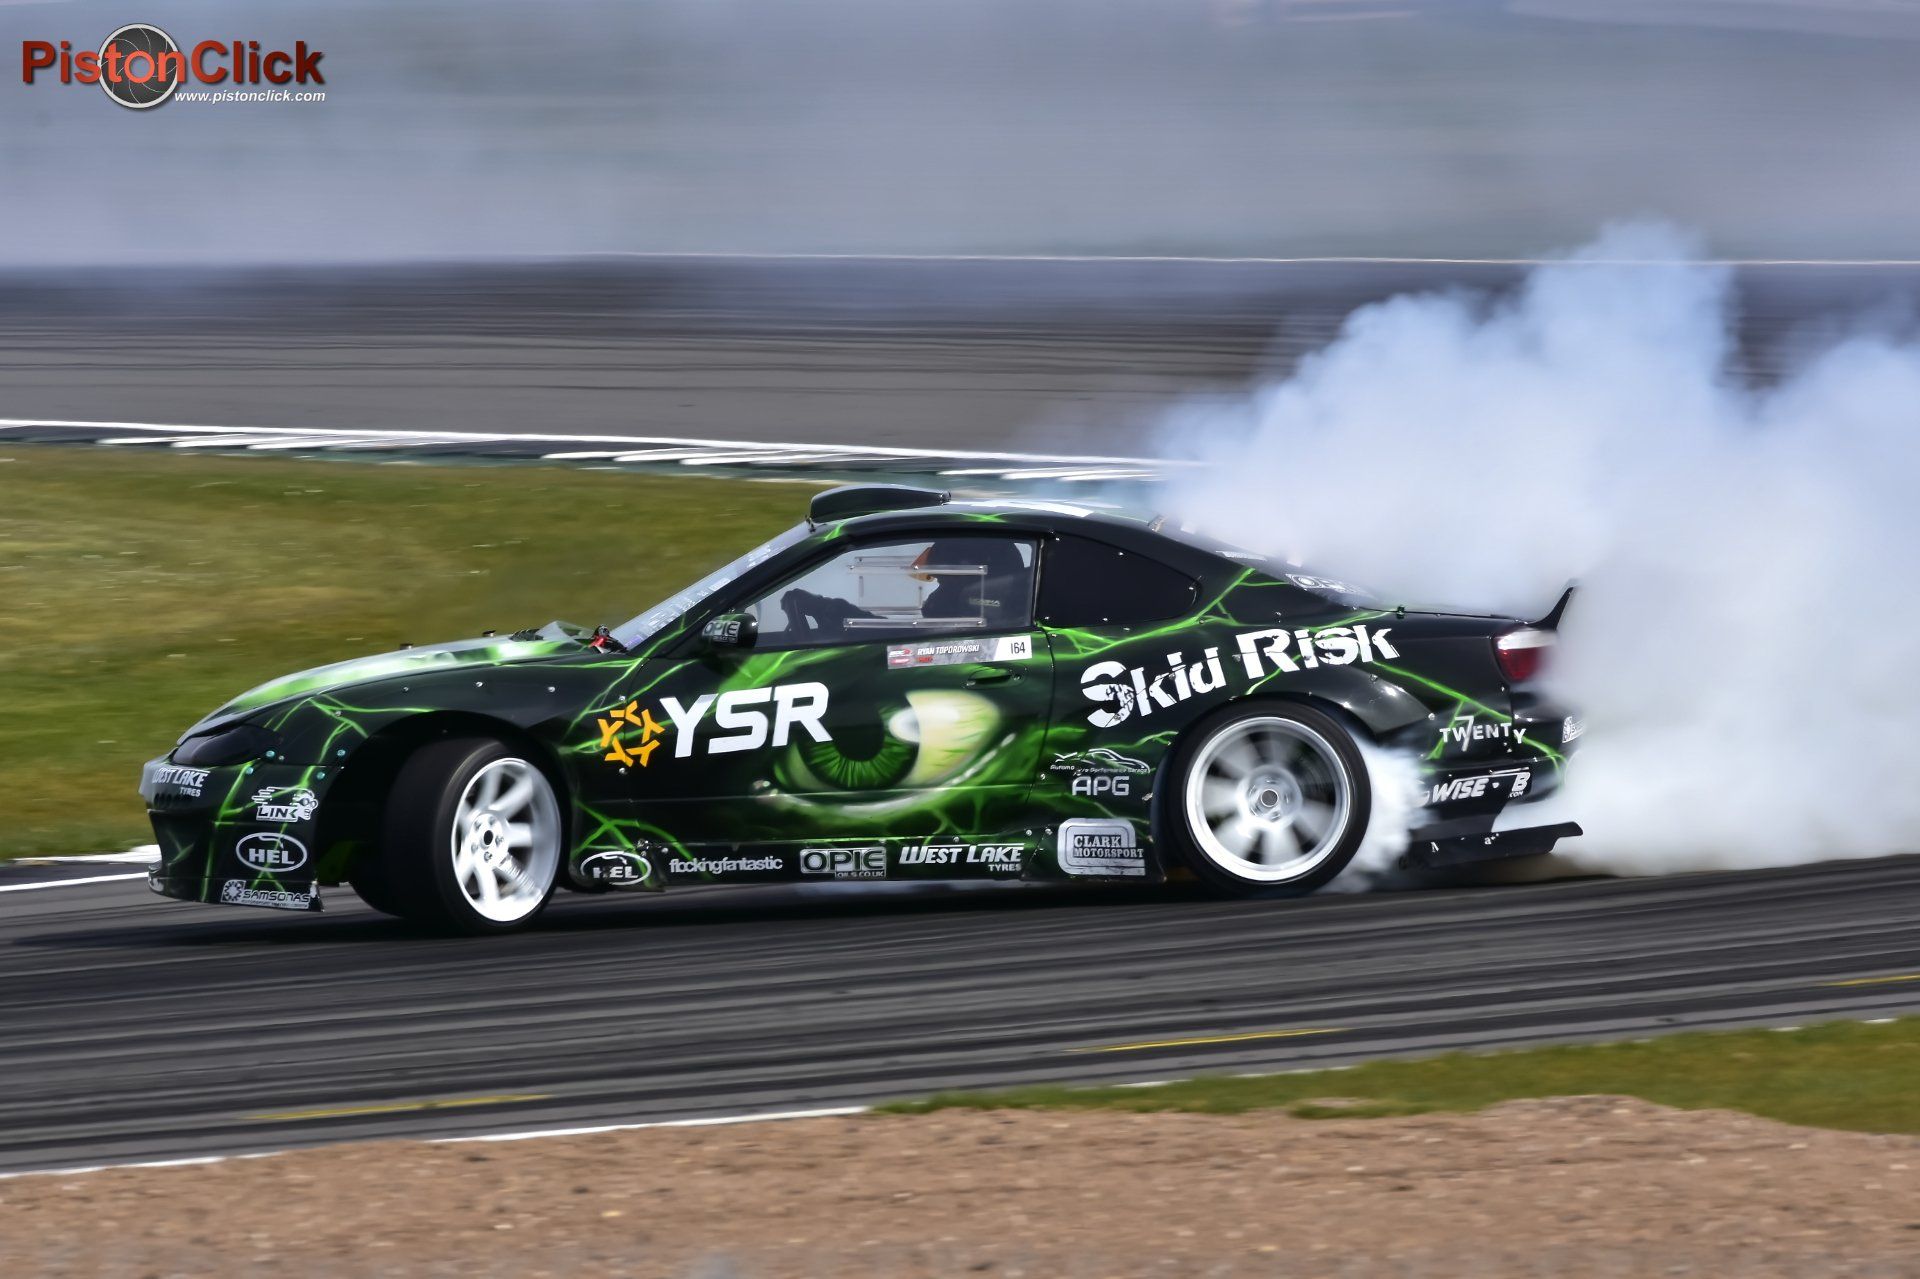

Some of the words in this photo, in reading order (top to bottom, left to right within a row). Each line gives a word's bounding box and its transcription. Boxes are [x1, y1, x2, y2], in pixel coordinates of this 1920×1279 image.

[702, 621, 738, 637] OPIE
[917, 648, 934, 656] RYAN
[936, 644, 979, 654] TOPOROWSKI
[1010, 641, 1026, 654] 164
[1080, 646, 1227, 728] Skid
[659, 681, 833, 758] YSR
[173, 768, 210, 787] LAKE
[1072, 776, 1129, 796] APG
[180, 787, 201, 797] TYRES
[1074, 835, 1121, 848] CLARK
[248, 848, 295, 865] HEL
[803, 850, 885, 871] OPIE
[899, 844, 969, 865] WEST
[966, 843, 1025, 863] LAKE
[1074, 848, 1144, 858] MOTORSPORT
[669, 856, 783, 875] flockingfantastic
[243, 890, 310, 903] SAMSONAS
